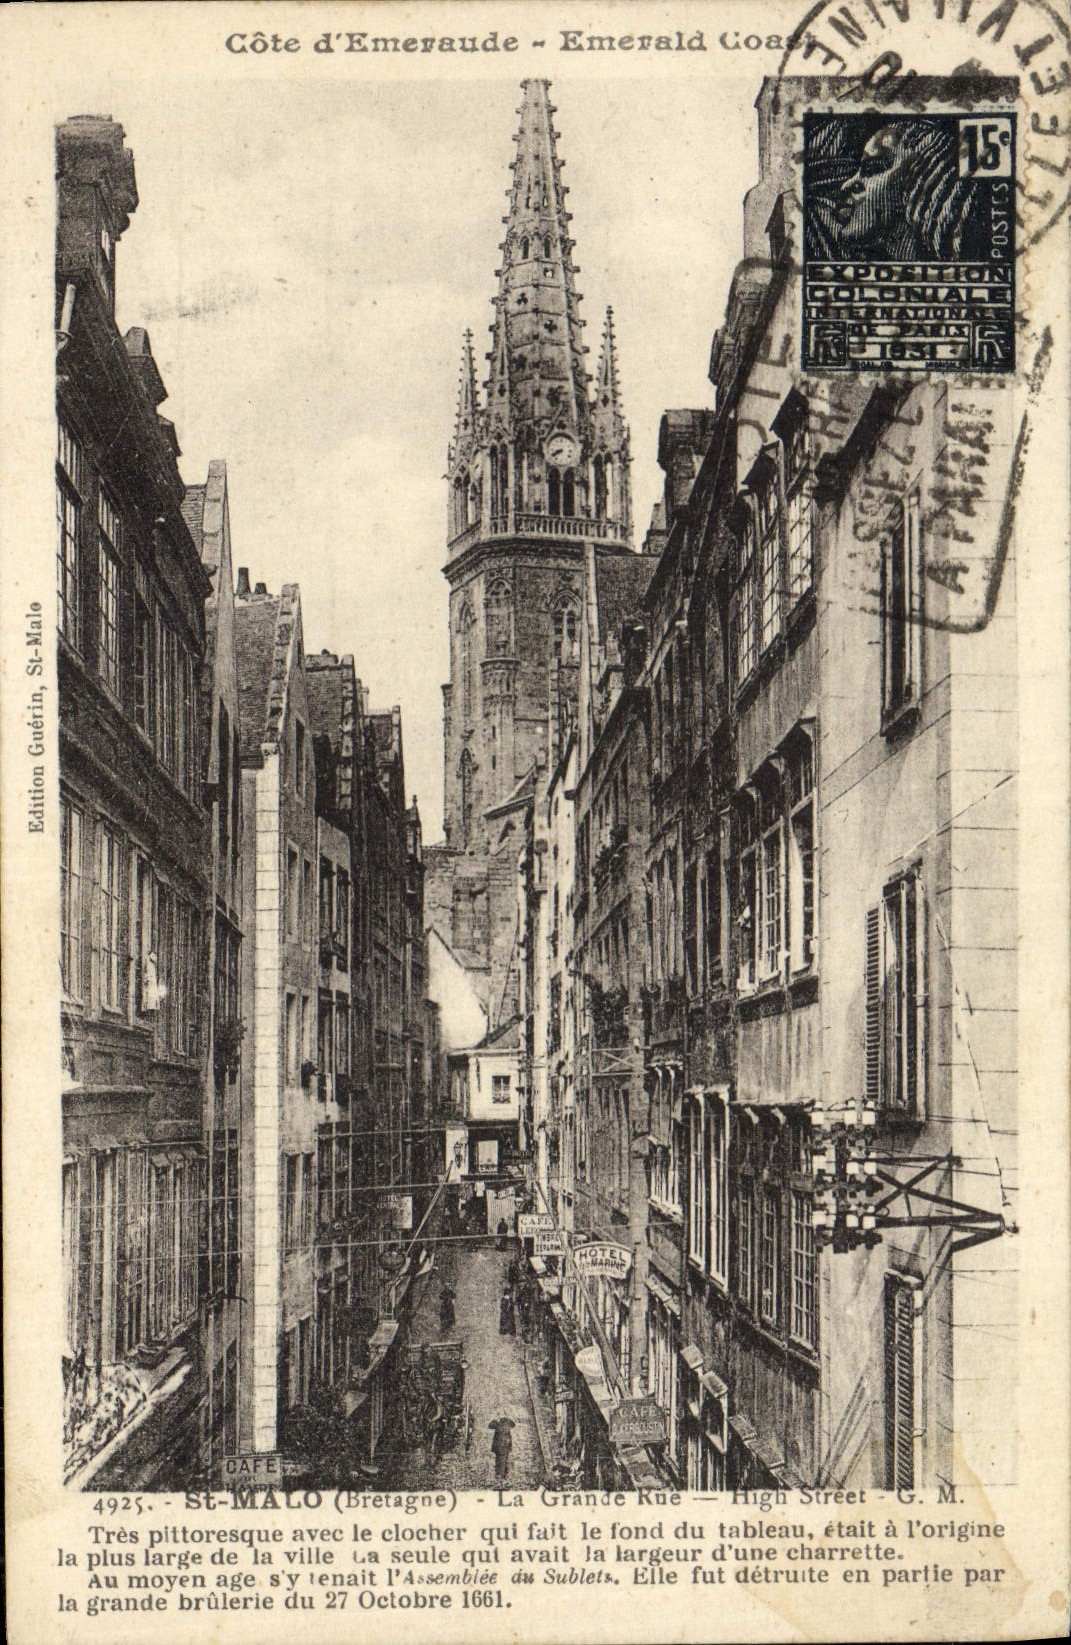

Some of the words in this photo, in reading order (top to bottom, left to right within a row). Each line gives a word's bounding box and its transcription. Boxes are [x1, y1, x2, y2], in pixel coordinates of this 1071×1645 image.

[990, 182, 1009, 260] POSTES
[807, 265, 1010, 282] EXPOSITION
[807, 286, 1011, 302] COLONIALE
[805, 307, 1010, 320] INTERNATIONALE
[901, 323, 967, 337] PARIS
[579, 1248, 627, 1263] HOTEL
